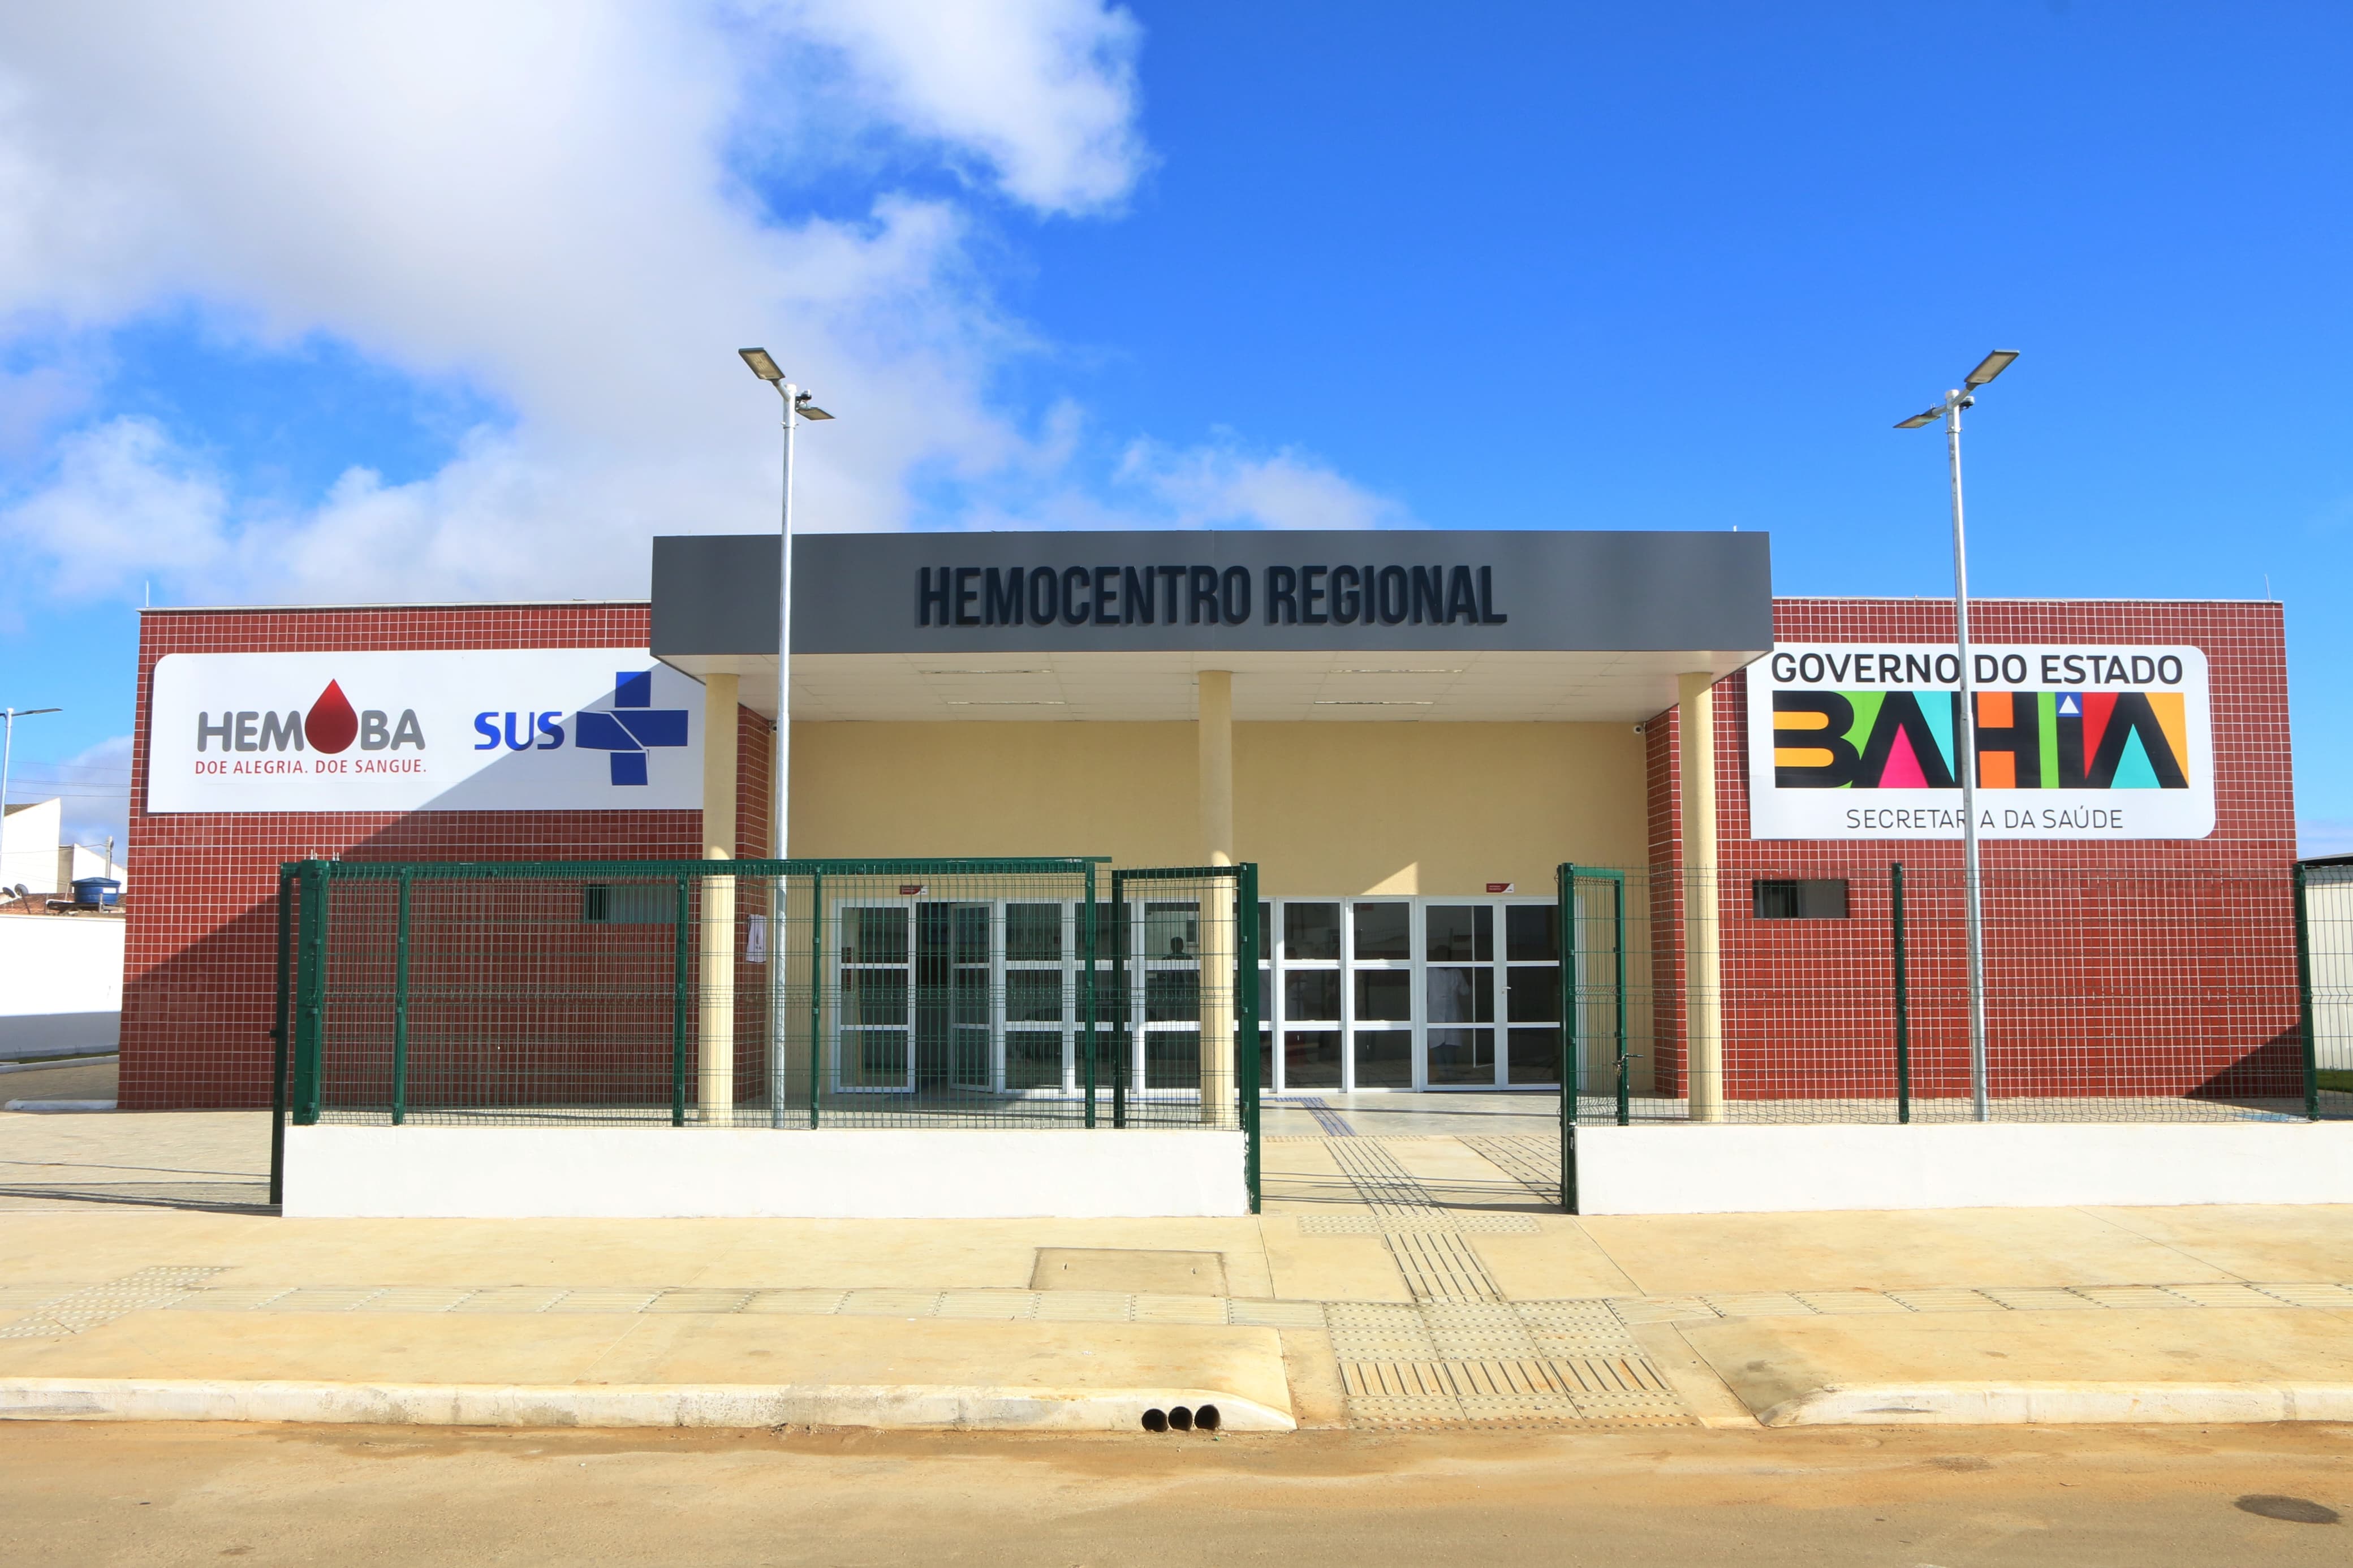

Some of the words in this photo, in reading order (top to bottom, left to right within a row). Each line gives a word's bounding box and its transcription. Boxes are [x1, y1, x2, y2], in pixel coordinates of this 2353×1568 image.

[919, 565, 1251, 626] HEMOCENTRO
[1268, 565, 1508, 624] REGIONAL
[1771, 653, 1960, 684] GOVERNO
[1975, 654, 2027, 684] DO
[2041, 655, 2183, 685] ESTADO
[475, 711, 565, 751] SUS
[1773, 691, 2189, 788] BAHIA
[195, 761, 227, 775] DOE
[233, 760, 307, 774] ALEGRIA.
[315, 759, 349, 774] DOE
[355, 759, 426, 774] SANGUE.
[1846, 809, 1995, 829] SECRETARA
[2005, 809, 2036, 829] DA
[2042, 805, 2123, 830] SAÚDE
